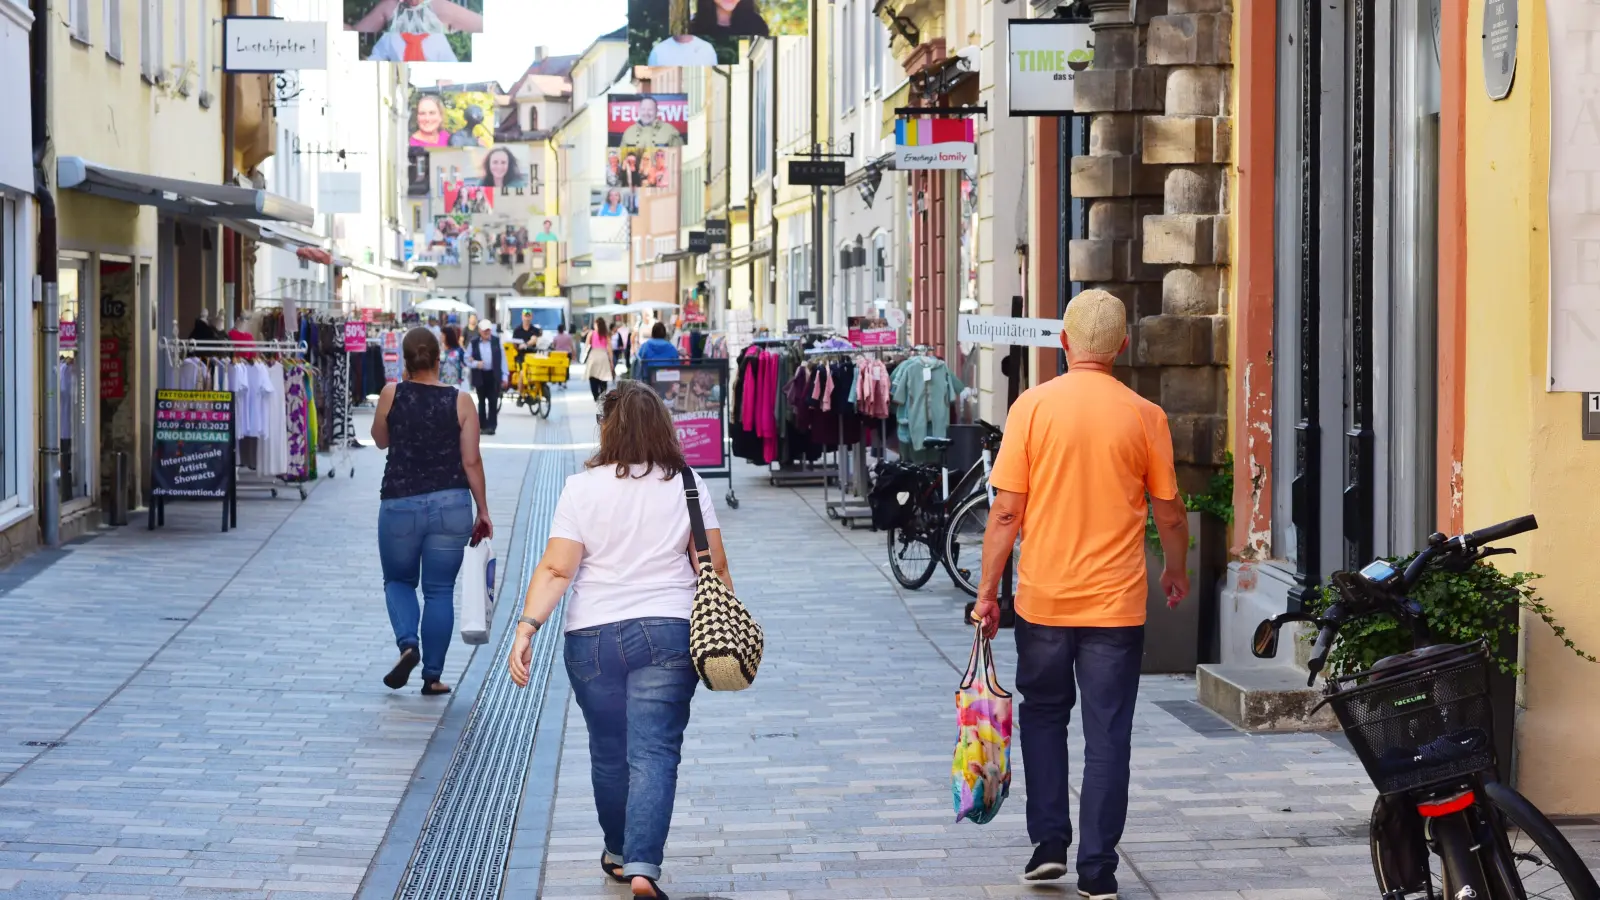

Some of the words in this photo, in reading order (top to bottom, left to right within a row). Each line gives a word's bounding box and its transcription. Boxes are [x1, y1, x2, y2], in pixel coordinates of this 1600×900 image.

[236, 36, 306, 57] Lustobjekte
[1053, 73, 1067, 81] das
[939, 152, 968, 163] family
[345, 324, 366, 338] 50%
[966, 318, 1036, 341] Antiquitäten
[158, 401, 230, 411] CONVENTION
[185, 421, 229, 430] 01.10.2023
[156, 431, 229, 441] ONOLDIASAAL
[160, 449, 222, 467] Internationale
[179, 462, 208, 474] Artists
[174, 471, 216, 485] Showacts
[153, 487, 226, 497] die-convention.de
